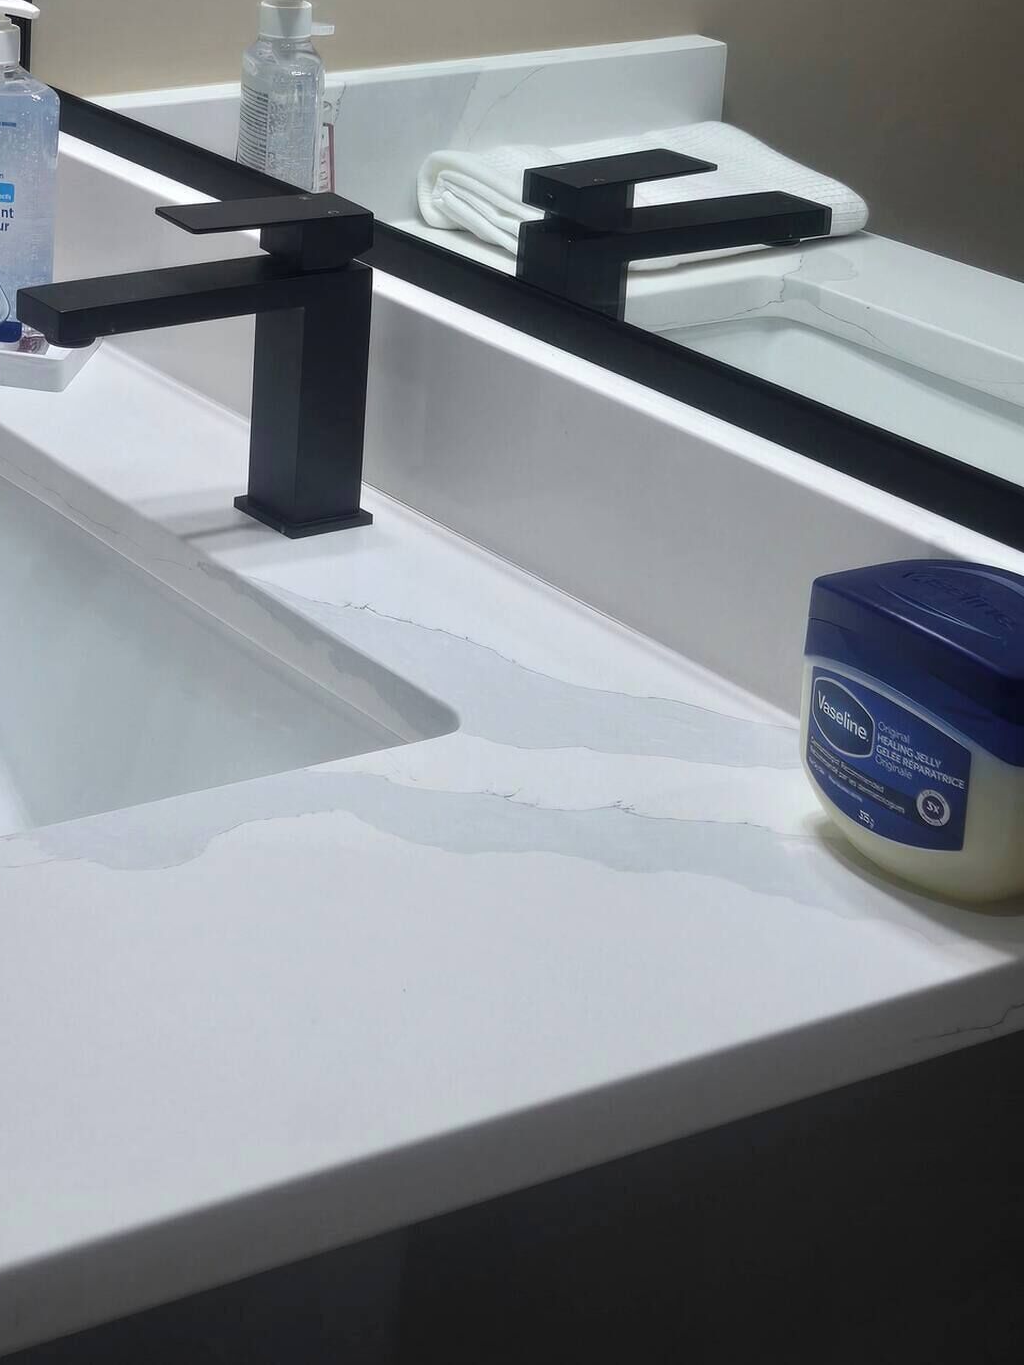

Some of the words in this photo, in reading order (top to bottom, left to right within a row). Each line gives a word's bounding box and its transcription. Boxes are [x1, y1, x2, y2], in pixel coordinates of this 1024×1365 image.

[817, 689, 867, 741] Vaseline
[877, 720, 910, 744] Original
[877, 732, 913, 758] HEALING
[914, 750, 942, 769] JELLY
